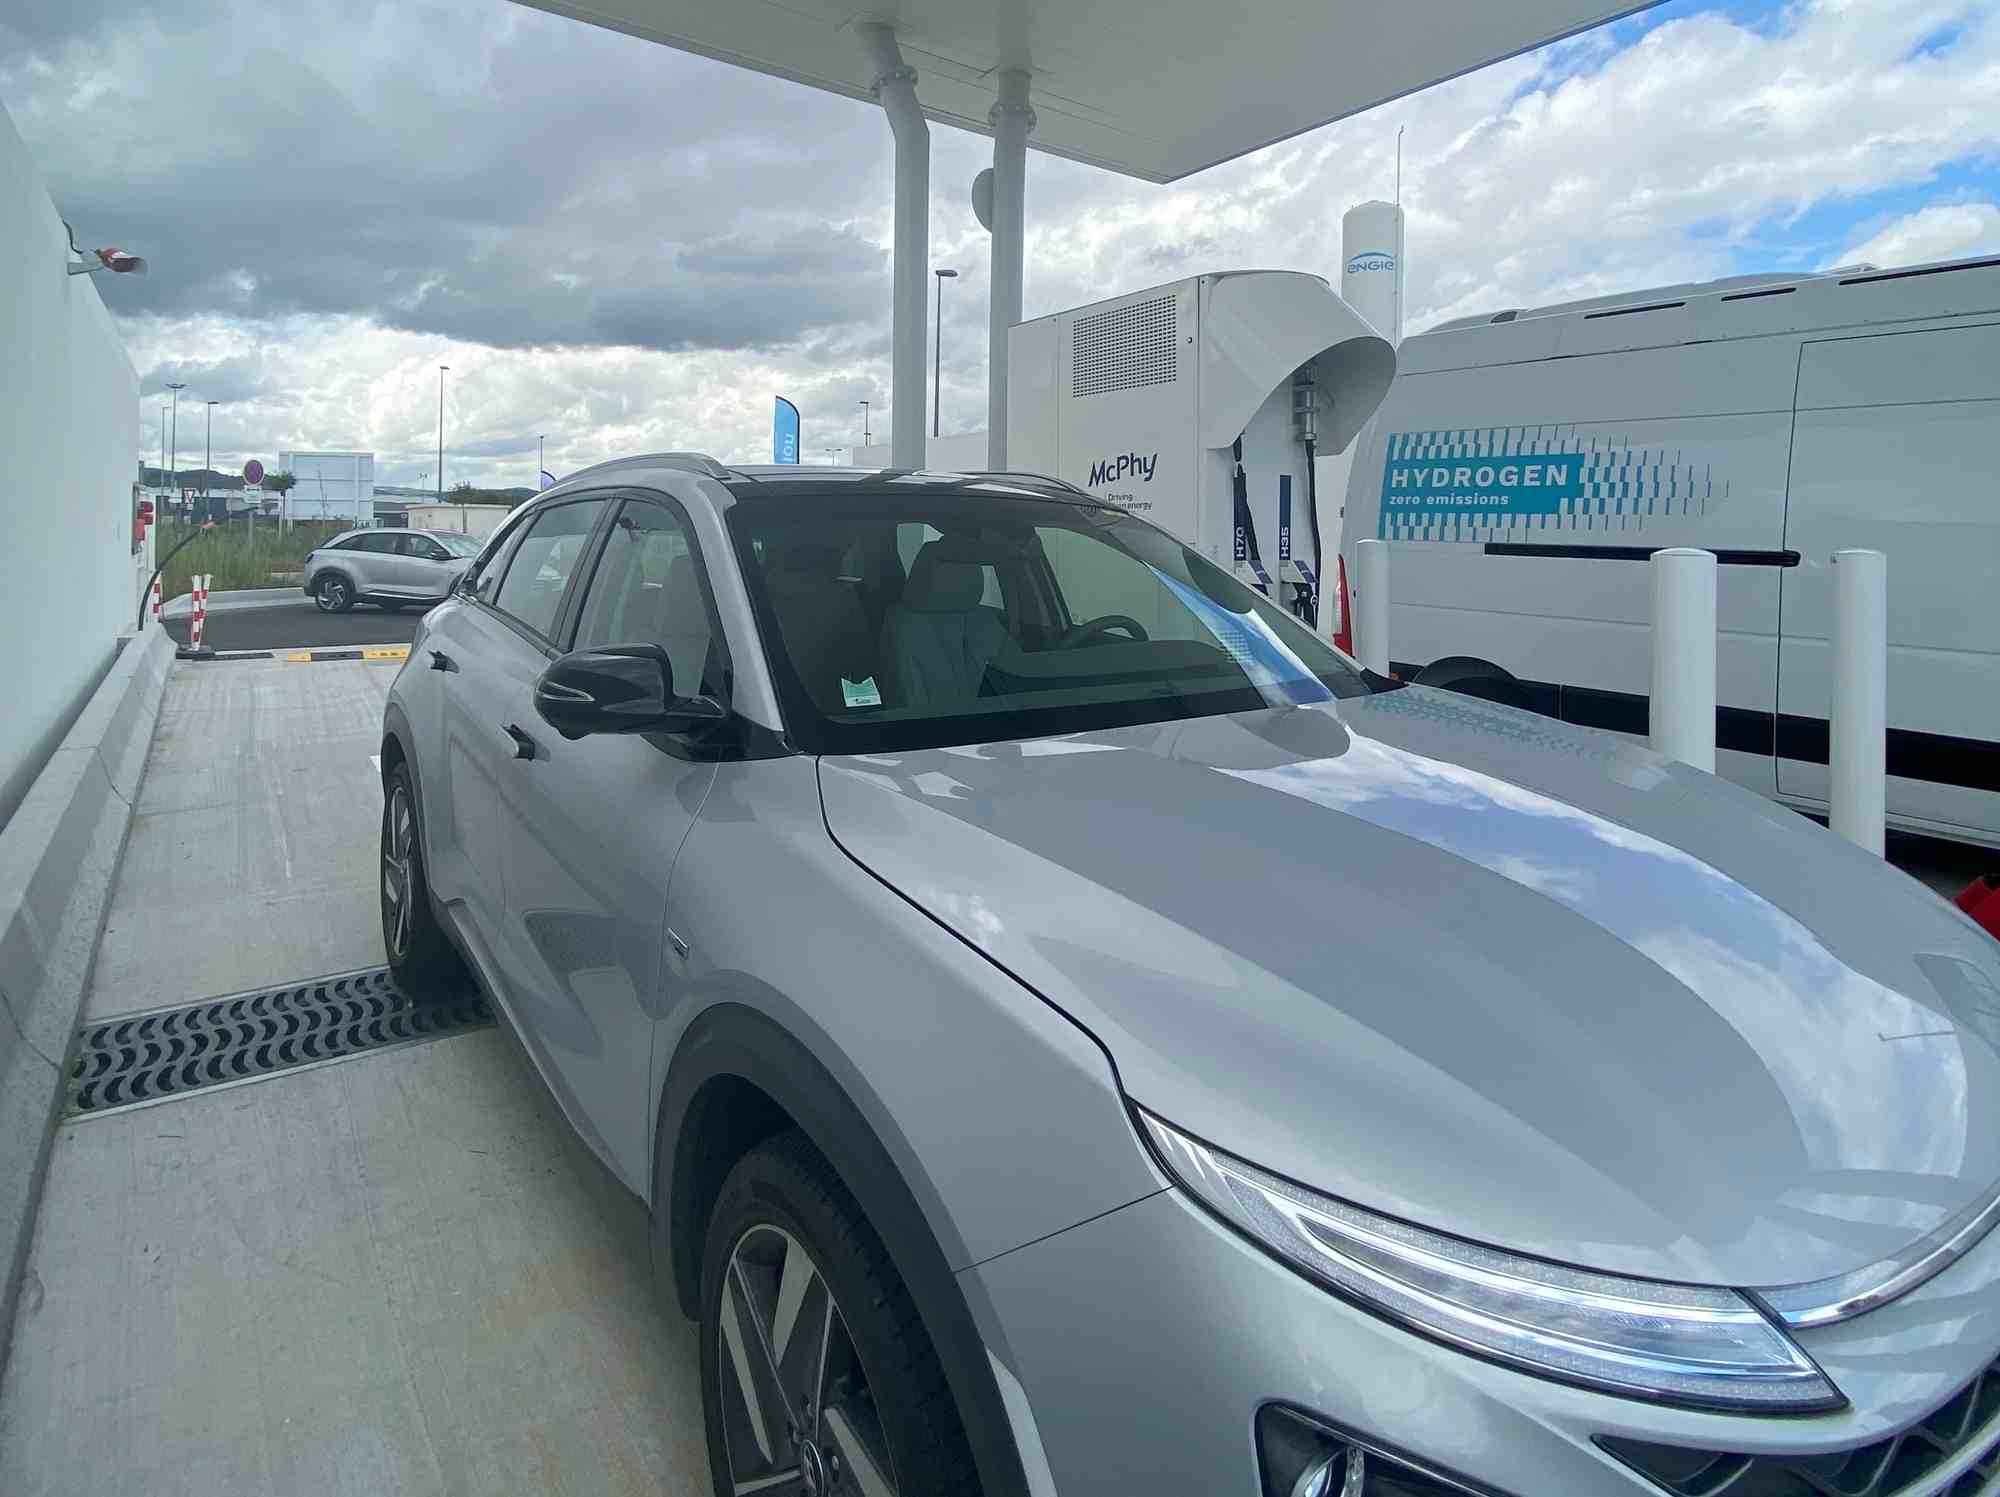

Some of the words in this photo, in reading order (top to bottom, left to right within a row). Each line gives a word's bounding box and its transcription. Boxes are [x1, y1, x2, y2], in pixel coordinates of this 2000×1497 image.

[1088, 452, 1158, 487] McPhy
[1391, 464, 1568, 488] HYDROGEN
[1389, 494, 1421, 505] zero
[1426, 492, 1509, 505] emissions
[1235, 526, 1245, 557] H70
[1280, 527, 1289, 557] H35
